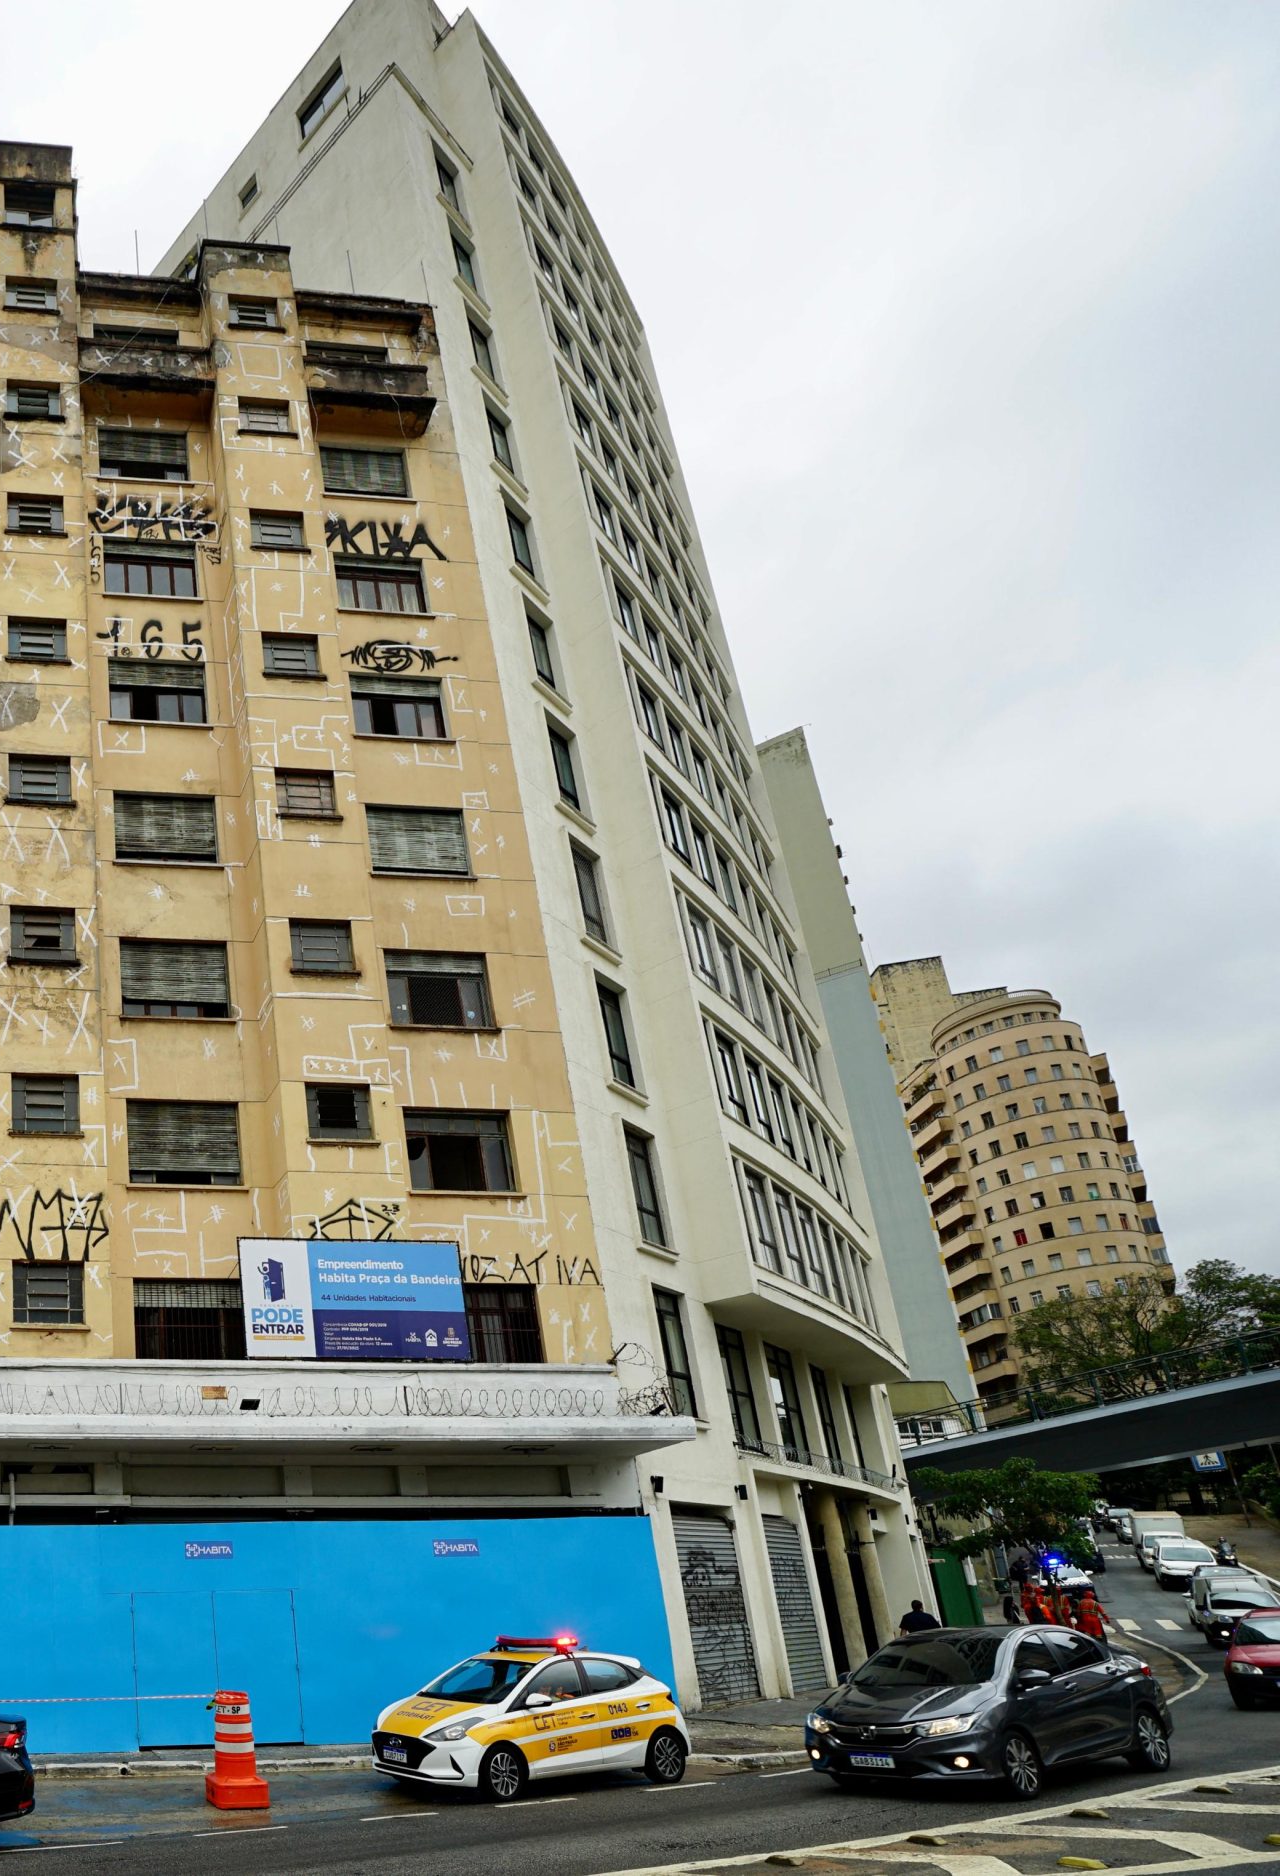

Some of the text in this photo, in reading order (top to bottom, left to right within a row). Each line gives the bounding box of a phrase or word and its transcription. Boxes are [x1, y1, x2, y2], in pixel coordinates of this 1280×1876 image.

[318, 1259, 404, 1270] Empreendimento
[319, 1273, 460, 1285] Habita Praça da Bandeira
[251, 1308, 304, 1323] PODE
[252, 1323, 304, 1335] ENTRAR
[198, 1545, 232, 1555] HABITA
[445, 1543, 478, 1552] HABITA
[608, 1702, 628, 1715] 0143
[533, 1712, 556, 1731] CET
